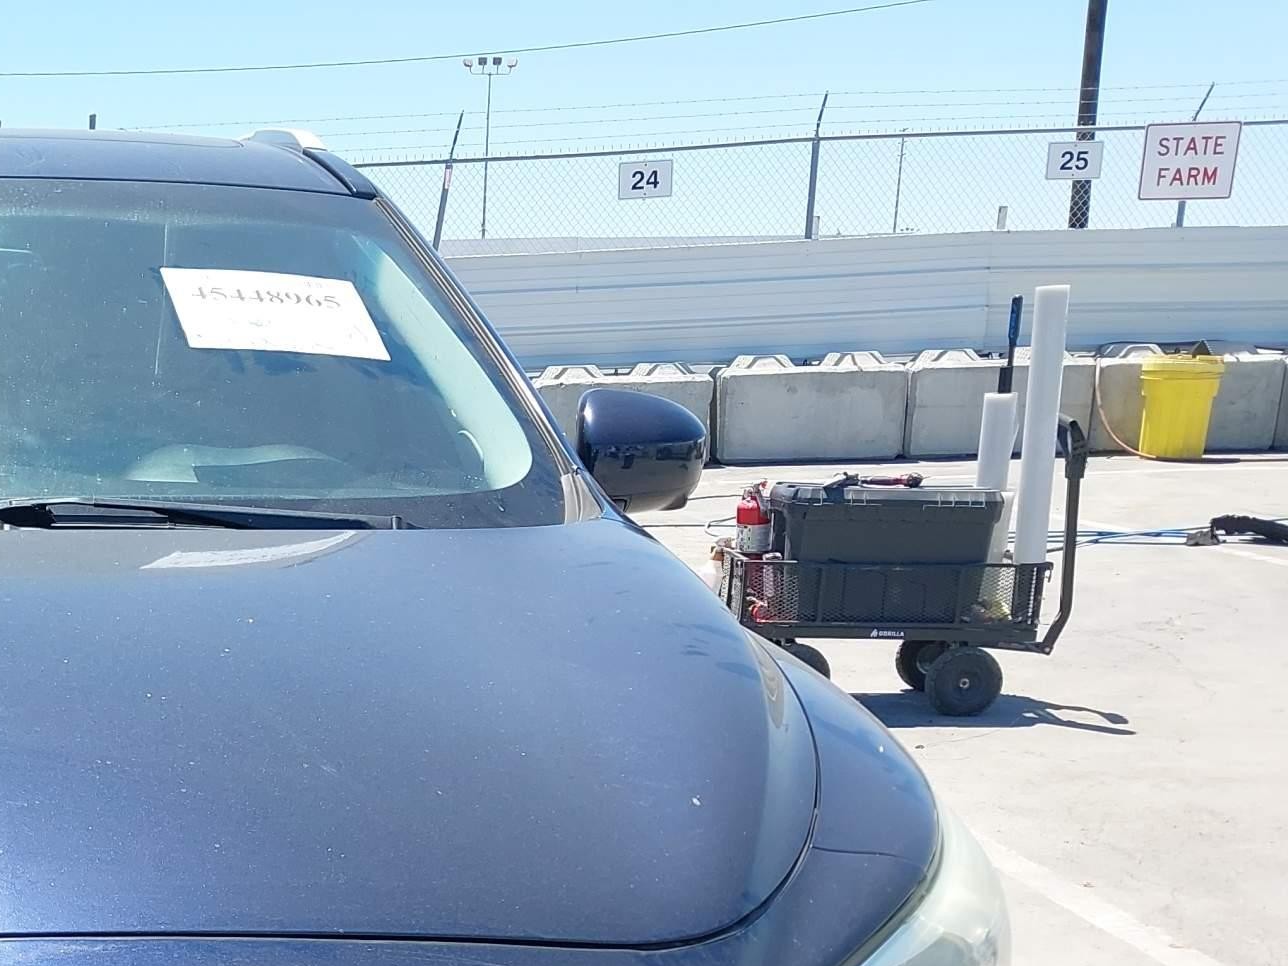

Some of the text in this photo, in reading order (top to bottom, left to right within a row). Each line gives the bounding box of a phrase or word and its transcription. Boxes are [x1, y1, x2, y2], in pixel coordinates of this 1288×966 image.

[1157, 135, 1227, 157] STATE
[1059, 150, 1089, 171] 25
[631, 169, 660, 191] 24
[1156, 166, 1219, 188] FARM
